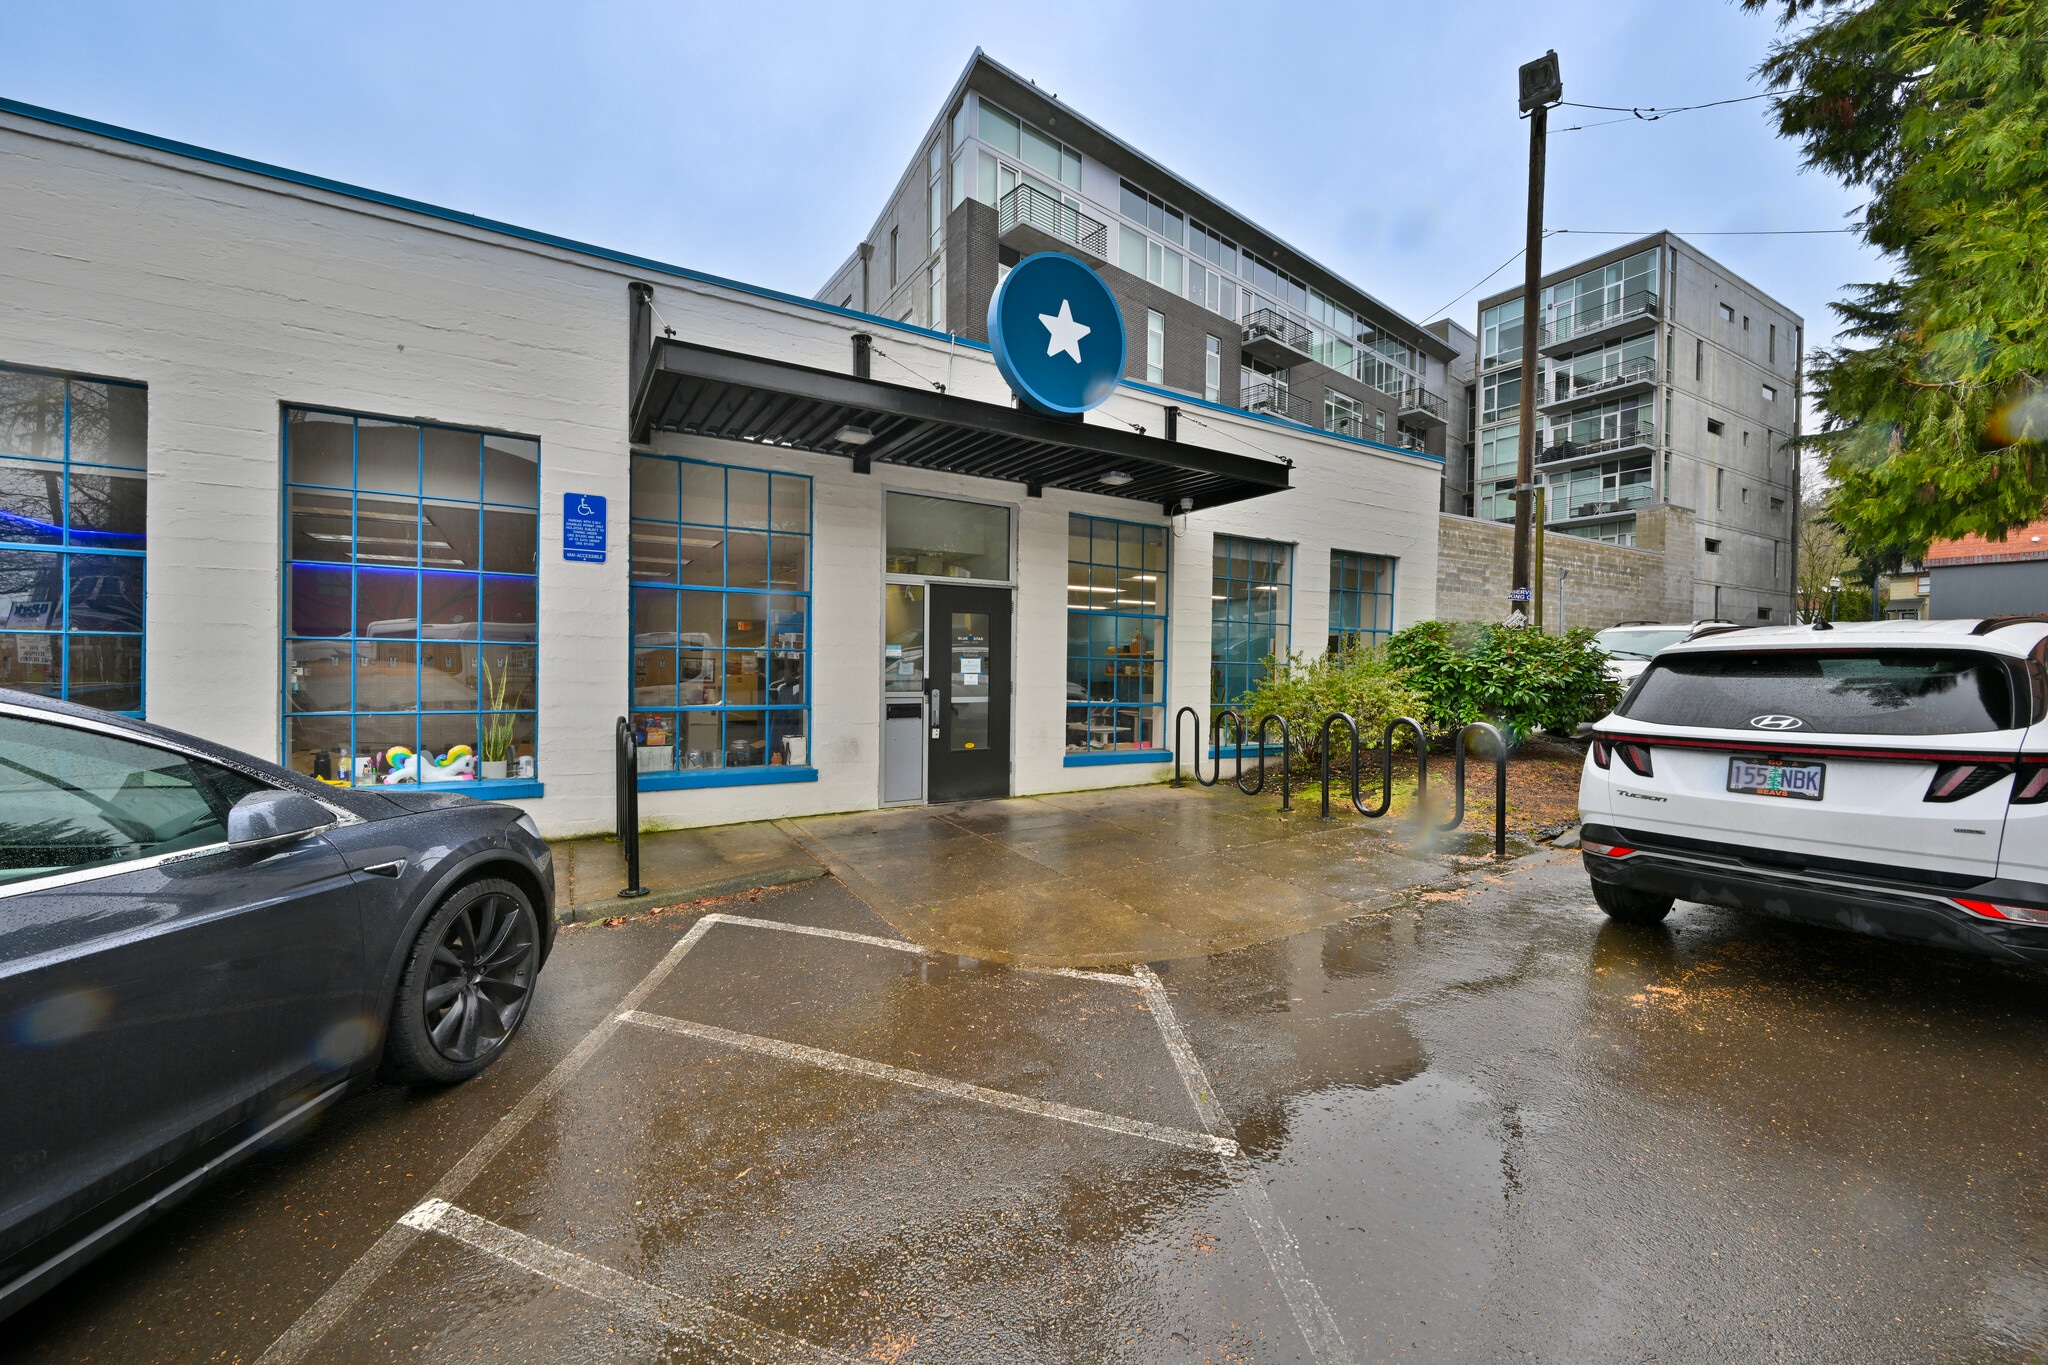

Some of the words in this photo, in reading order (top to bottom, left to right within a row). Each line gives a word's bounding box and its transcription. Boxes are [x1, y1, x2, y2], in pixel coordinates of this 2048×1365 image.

[1735, 766, 1768, 785] 155
[1781, 769, 1819, 791] NBK
[1756, 788, 1789, 797] BEAVS
